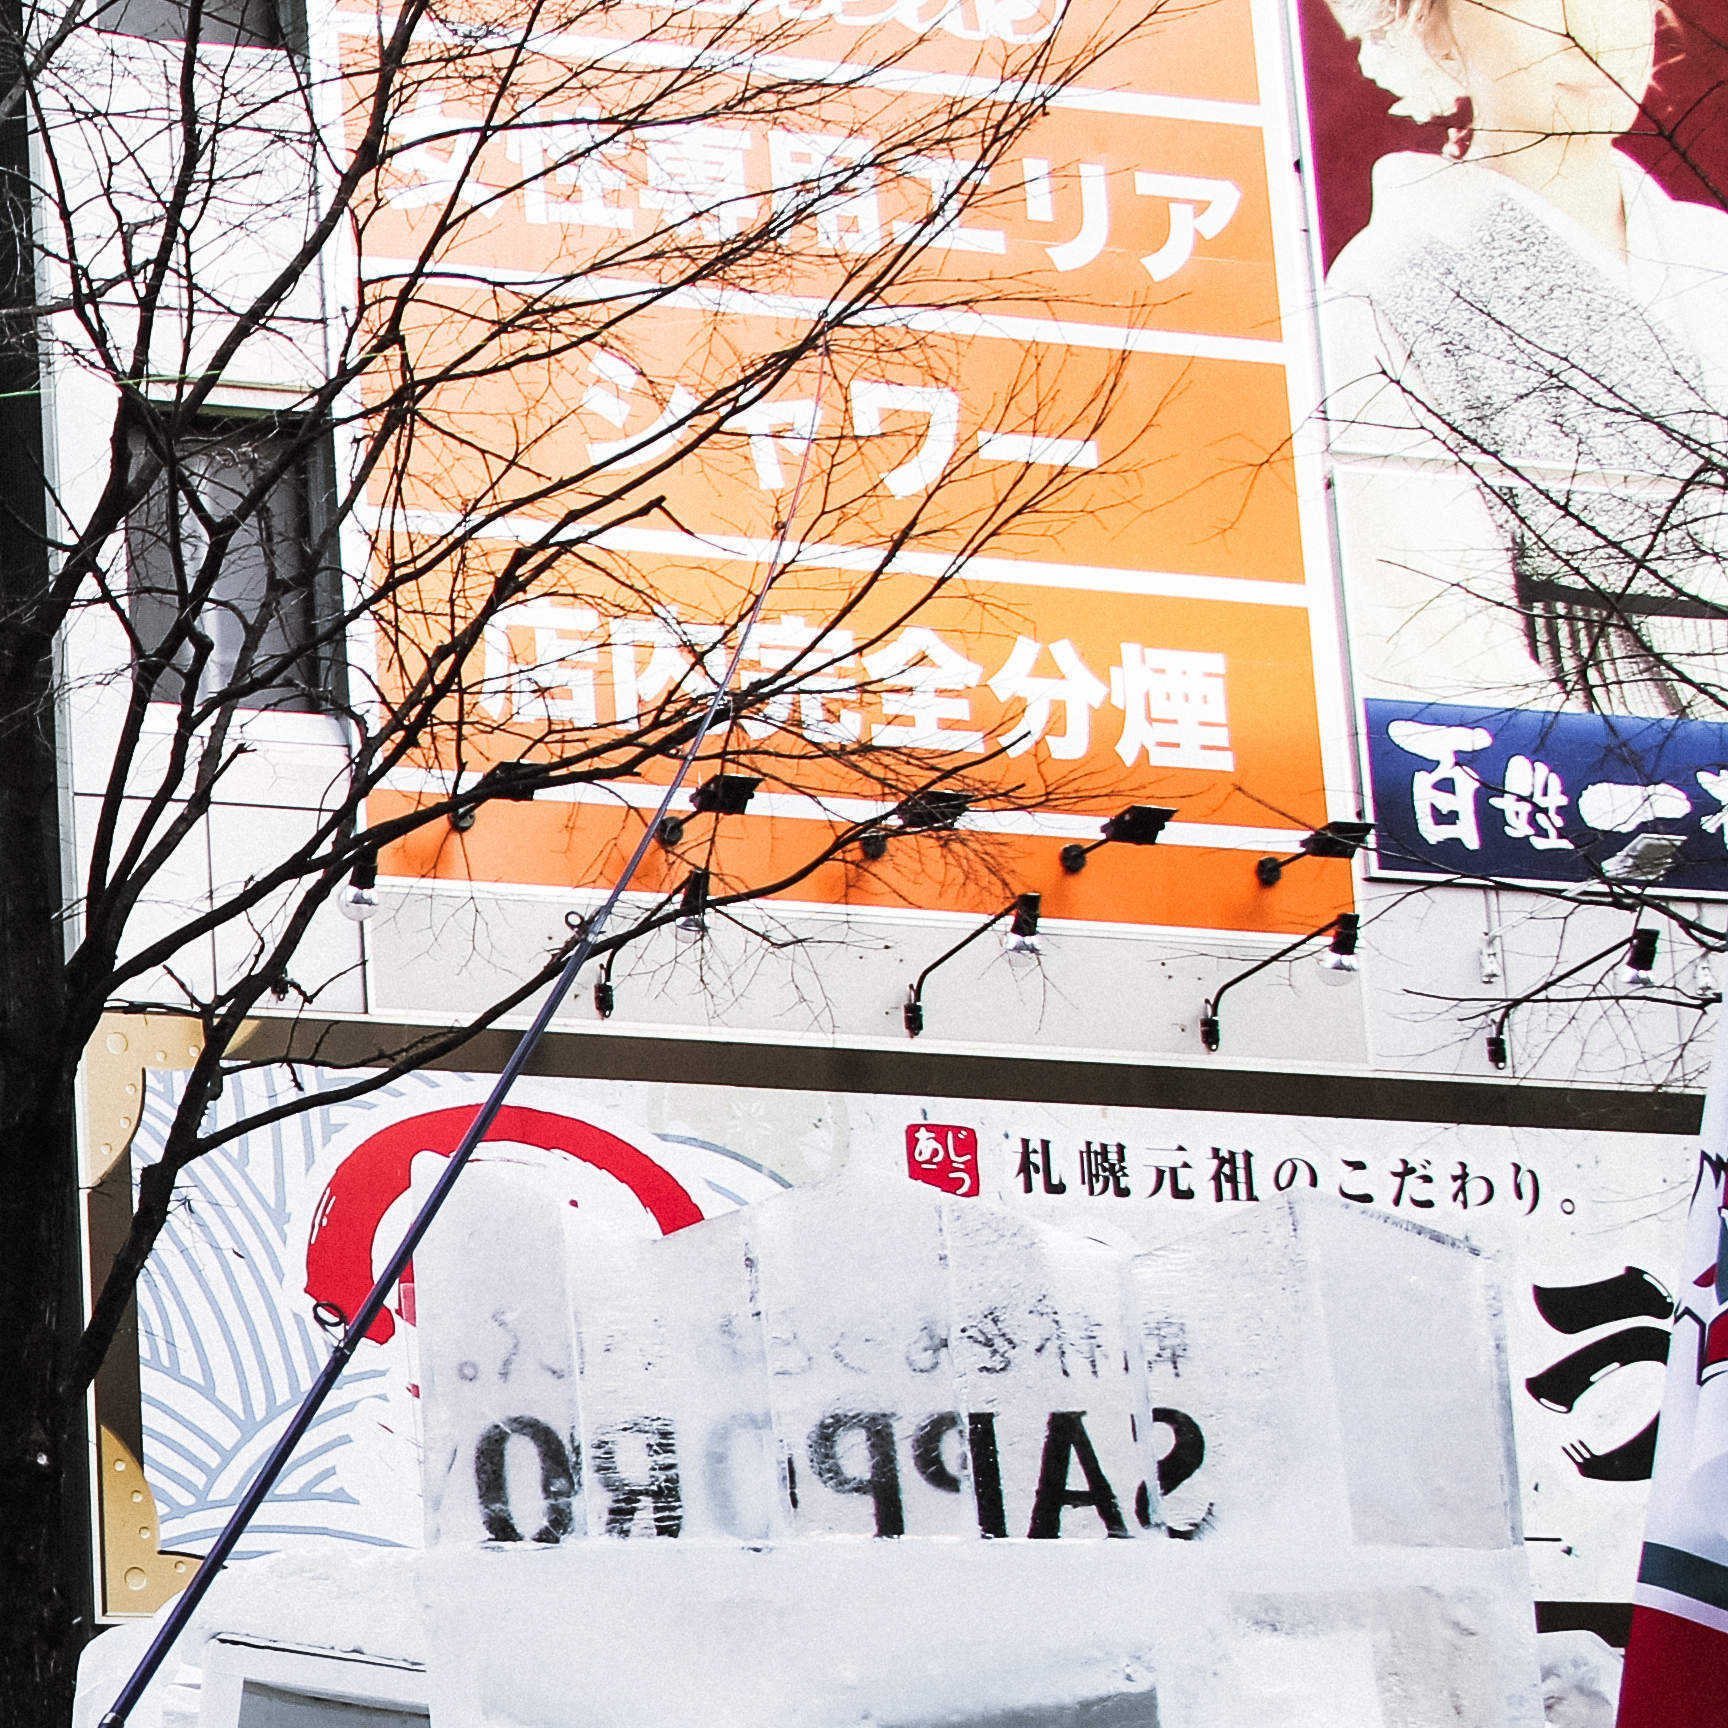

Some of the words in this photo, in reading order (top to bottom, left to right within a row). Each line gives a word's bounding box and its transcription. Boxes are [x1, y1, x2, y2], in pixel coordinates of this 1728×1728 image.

[582, 348, 1100, 501] シャワー
[482, 602, 1238, 774] 店内完全分煙
[1013, 1137, 1577, 1217] 札幌元祖のこだわり。
